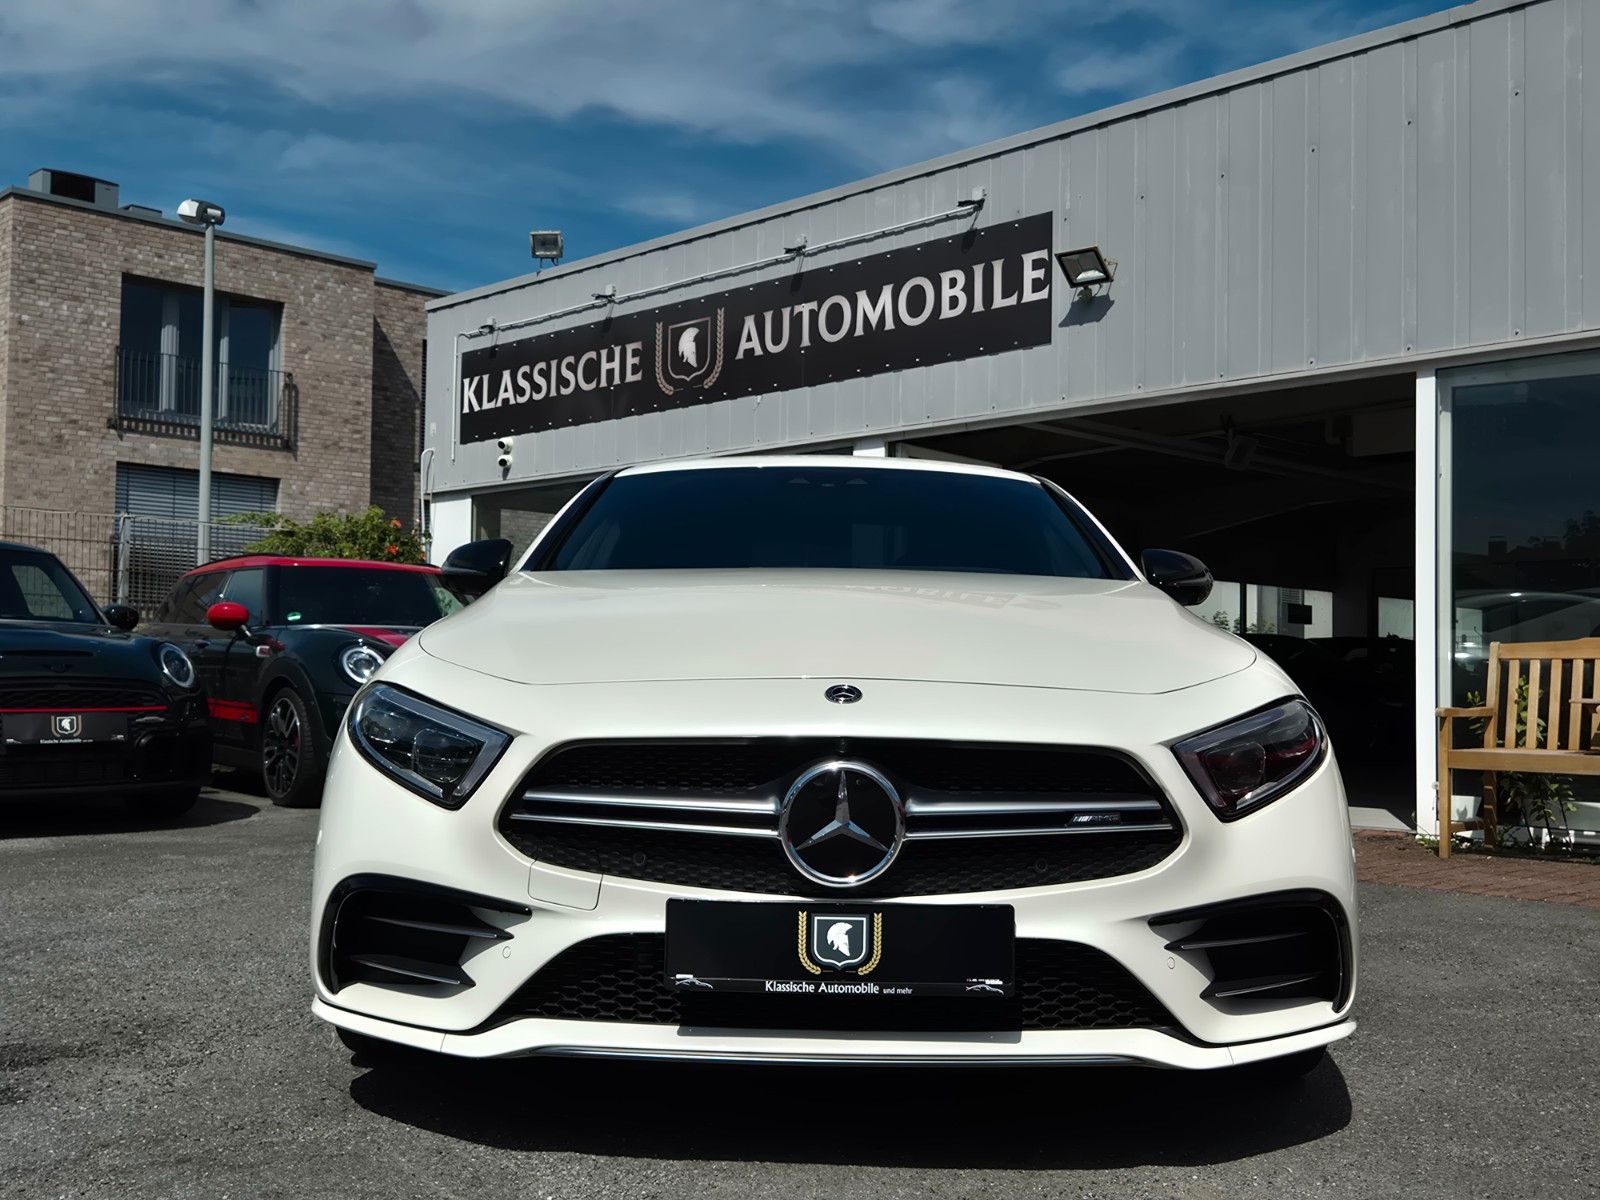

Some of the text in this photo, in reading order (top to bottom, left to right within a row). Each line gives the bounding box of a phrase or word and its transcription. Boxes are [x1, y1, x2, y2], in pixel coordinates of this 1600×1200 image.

[462, 249, 1049, 413] KLASSISCHE AUTOMOBILE
[765, 980, 913, 995] Klassische Automobile und mehr
